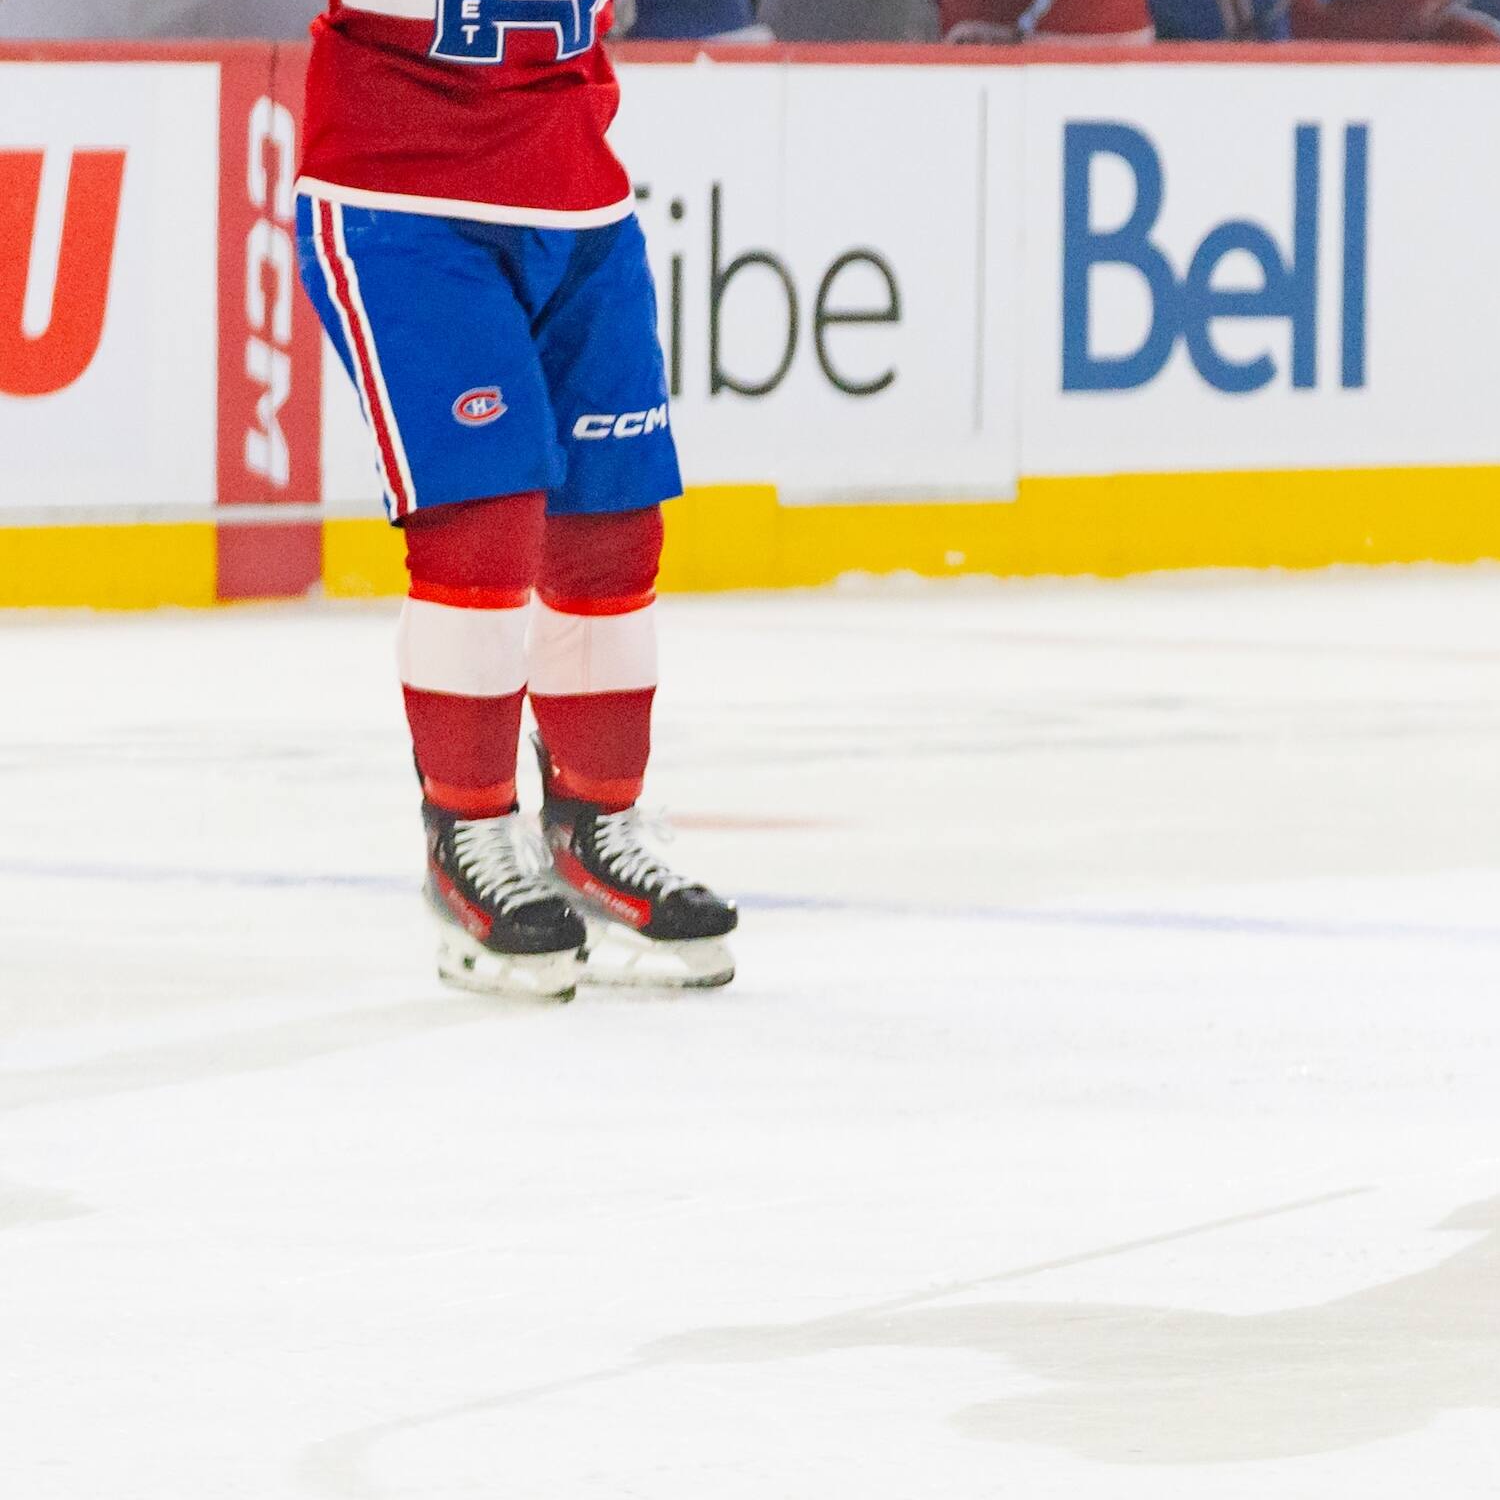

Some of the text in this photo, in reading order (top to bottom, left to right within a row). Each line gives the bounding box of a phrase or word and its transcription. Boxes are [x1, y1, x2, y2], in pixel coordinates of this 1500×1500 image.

[244, 94, 296, 488] CCM
[634, 181, 904, 398] ibe
[1060, 118, 1372, 395] Bell
[571, 402, 669, 441] CCM
